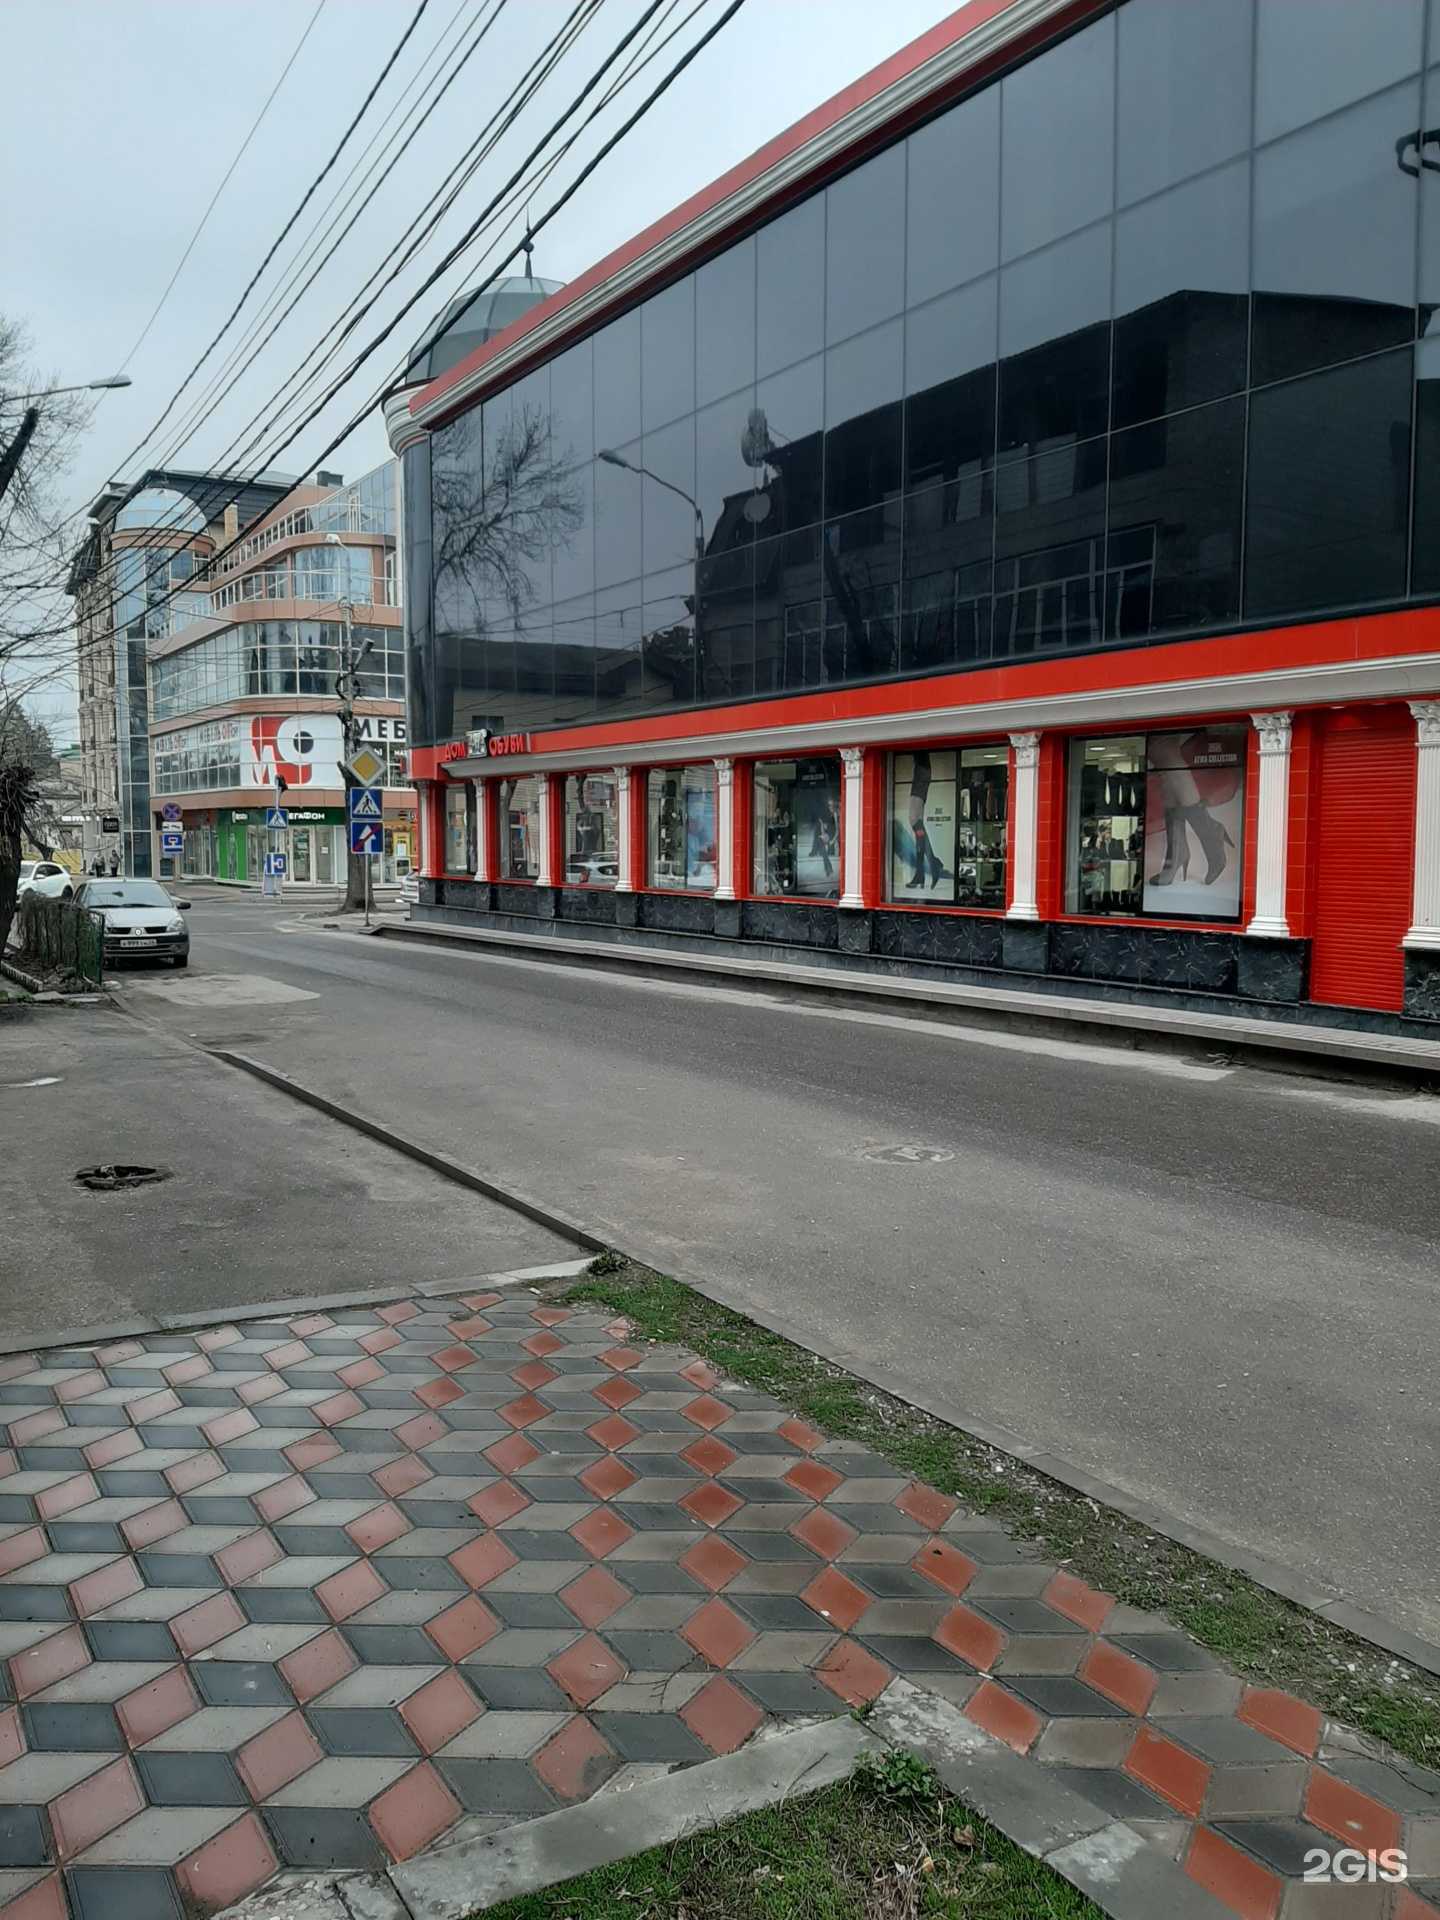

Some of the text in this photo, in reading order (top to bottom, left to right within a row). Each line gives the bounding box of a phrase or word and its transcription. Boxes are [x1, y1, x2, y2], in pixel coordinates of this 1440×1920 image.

[444, 733, 524, 760] ДОМ ОБУВИ
[288, 811, 325, 820] ЕГАФОН
